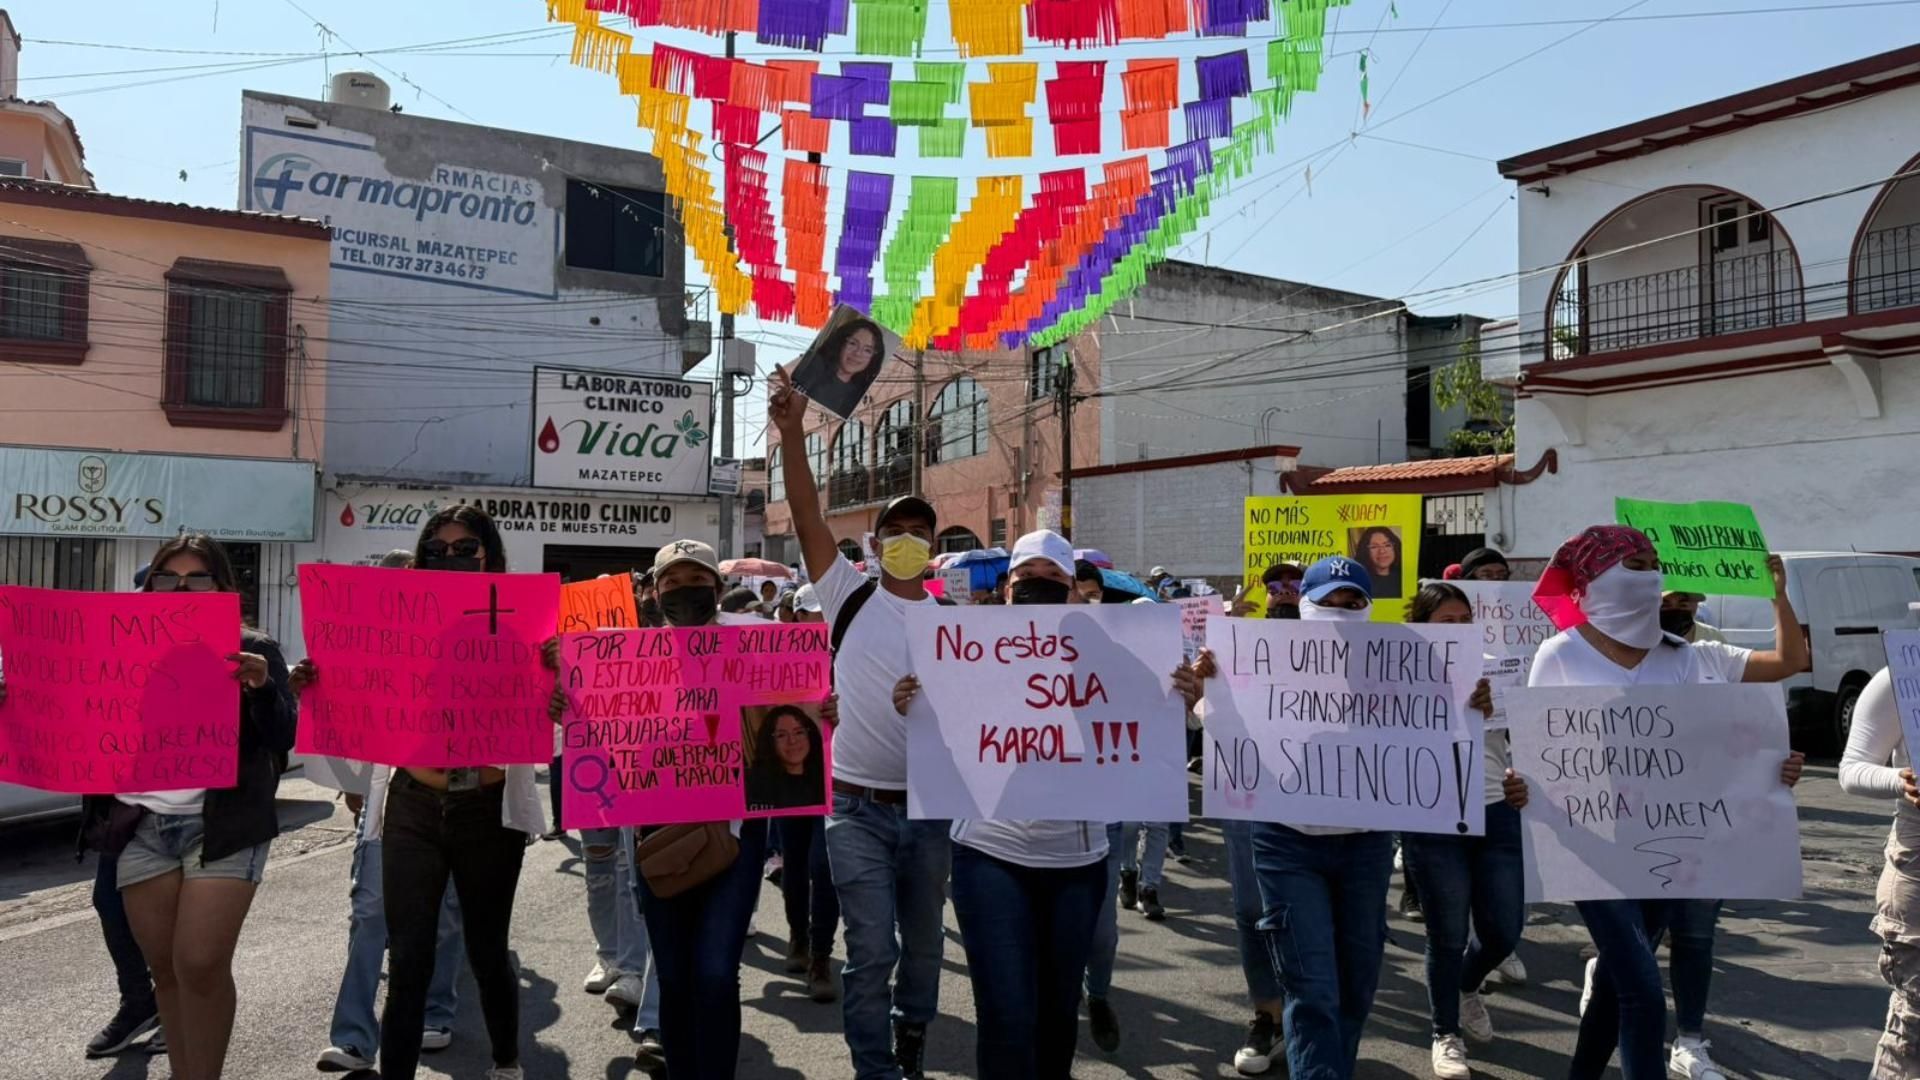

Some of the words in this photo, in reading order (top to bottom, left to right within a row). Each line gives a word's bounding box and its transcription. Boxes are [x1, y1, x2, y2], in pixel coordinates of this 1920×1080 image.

[428, 168, 533, 197] RMACIAS
[332, 227, 411, 253] UCURSAL
[416, 240, 518, 266] MAZATEPEC
[561, 373, 692, 399] LABORATORIO
[585, 396, 664, 414] CLINICO
[560, 418, 680, 459] Vida
[578, 468, 664, 483] MAZATEPEC
[15, 493, 163, 524] ROSSY'S
[360, 503, 422, 525] Vida
[461, 498, 591, 521] ABORATORIO
[600, 504, 672, 524] CLINICO
[1250, 508, 1271, 524] NO
[1275, 501, 1310, 526] MÁS
[1337, 503, 1388, 523] #UAEM
[52, 524, 79, 533] GLAM
[80, 525, 127, 534] BOUTIQUE
[495, 520, 535, 532] TOMA
[541, 522, 557, 533] DE
[562, 522, 638, 535] MUESTRAS
[1249, 529, 1334, 548] ESTUDIANTES
[1669, 524, 1765, 549] INDIFERENCIA
[1714, 558, 1760, 580] duele
[378, 585, 443, 626] UNA
[311, 620, 444, 659] PROHIBIDO
[573, 632, 630, 660] POR
[636, 631, 673, 659] LAS
[687, 630, 726, 657] QUE
[738, 628, 829, 653] SALIERON
[936, 624, 984, 662] No
[994, 620, 1080, 665] estas
[1503, 624, 1558, 646] EXIST
[1232, 624, 1271, 676] LA
[1290, 638, 1351, 676] UAEM
[1365, 637, 1459, 685] MERECE
[38, 655, 181, 692] DEJEMOS
[411, 671, 439, 703] DE
[451, 673, 549, 700] BUSCAR
[569, 665, 583, 688] A
[593, 659, 683, 689] ESTUDIAR
[700, 658, 712, 684] Y
[722, 661, 745, 685] NO
[747, 660, 823, 692] #UAEM
[567, 691, 662, 719] VOLVIERON
[675, 687, 719, 712] PARA
[1025, 672, 1109, 709] SOLA
[1263, 683, 1449, 732] TRANSPARENCIA
[1547, 705, 1675, 740] EXIGIMOS
[652, 740, 741, 769] QUEREMOS
[1213, 737, 1260, 792] NO
[1541, 746, 1685, 783] SEGURIDAD
[617, 769, 659, 790] VIVA
[1564, 791, 1633, 828] PARA
[1645, 798, 1733, 829] UAEM
